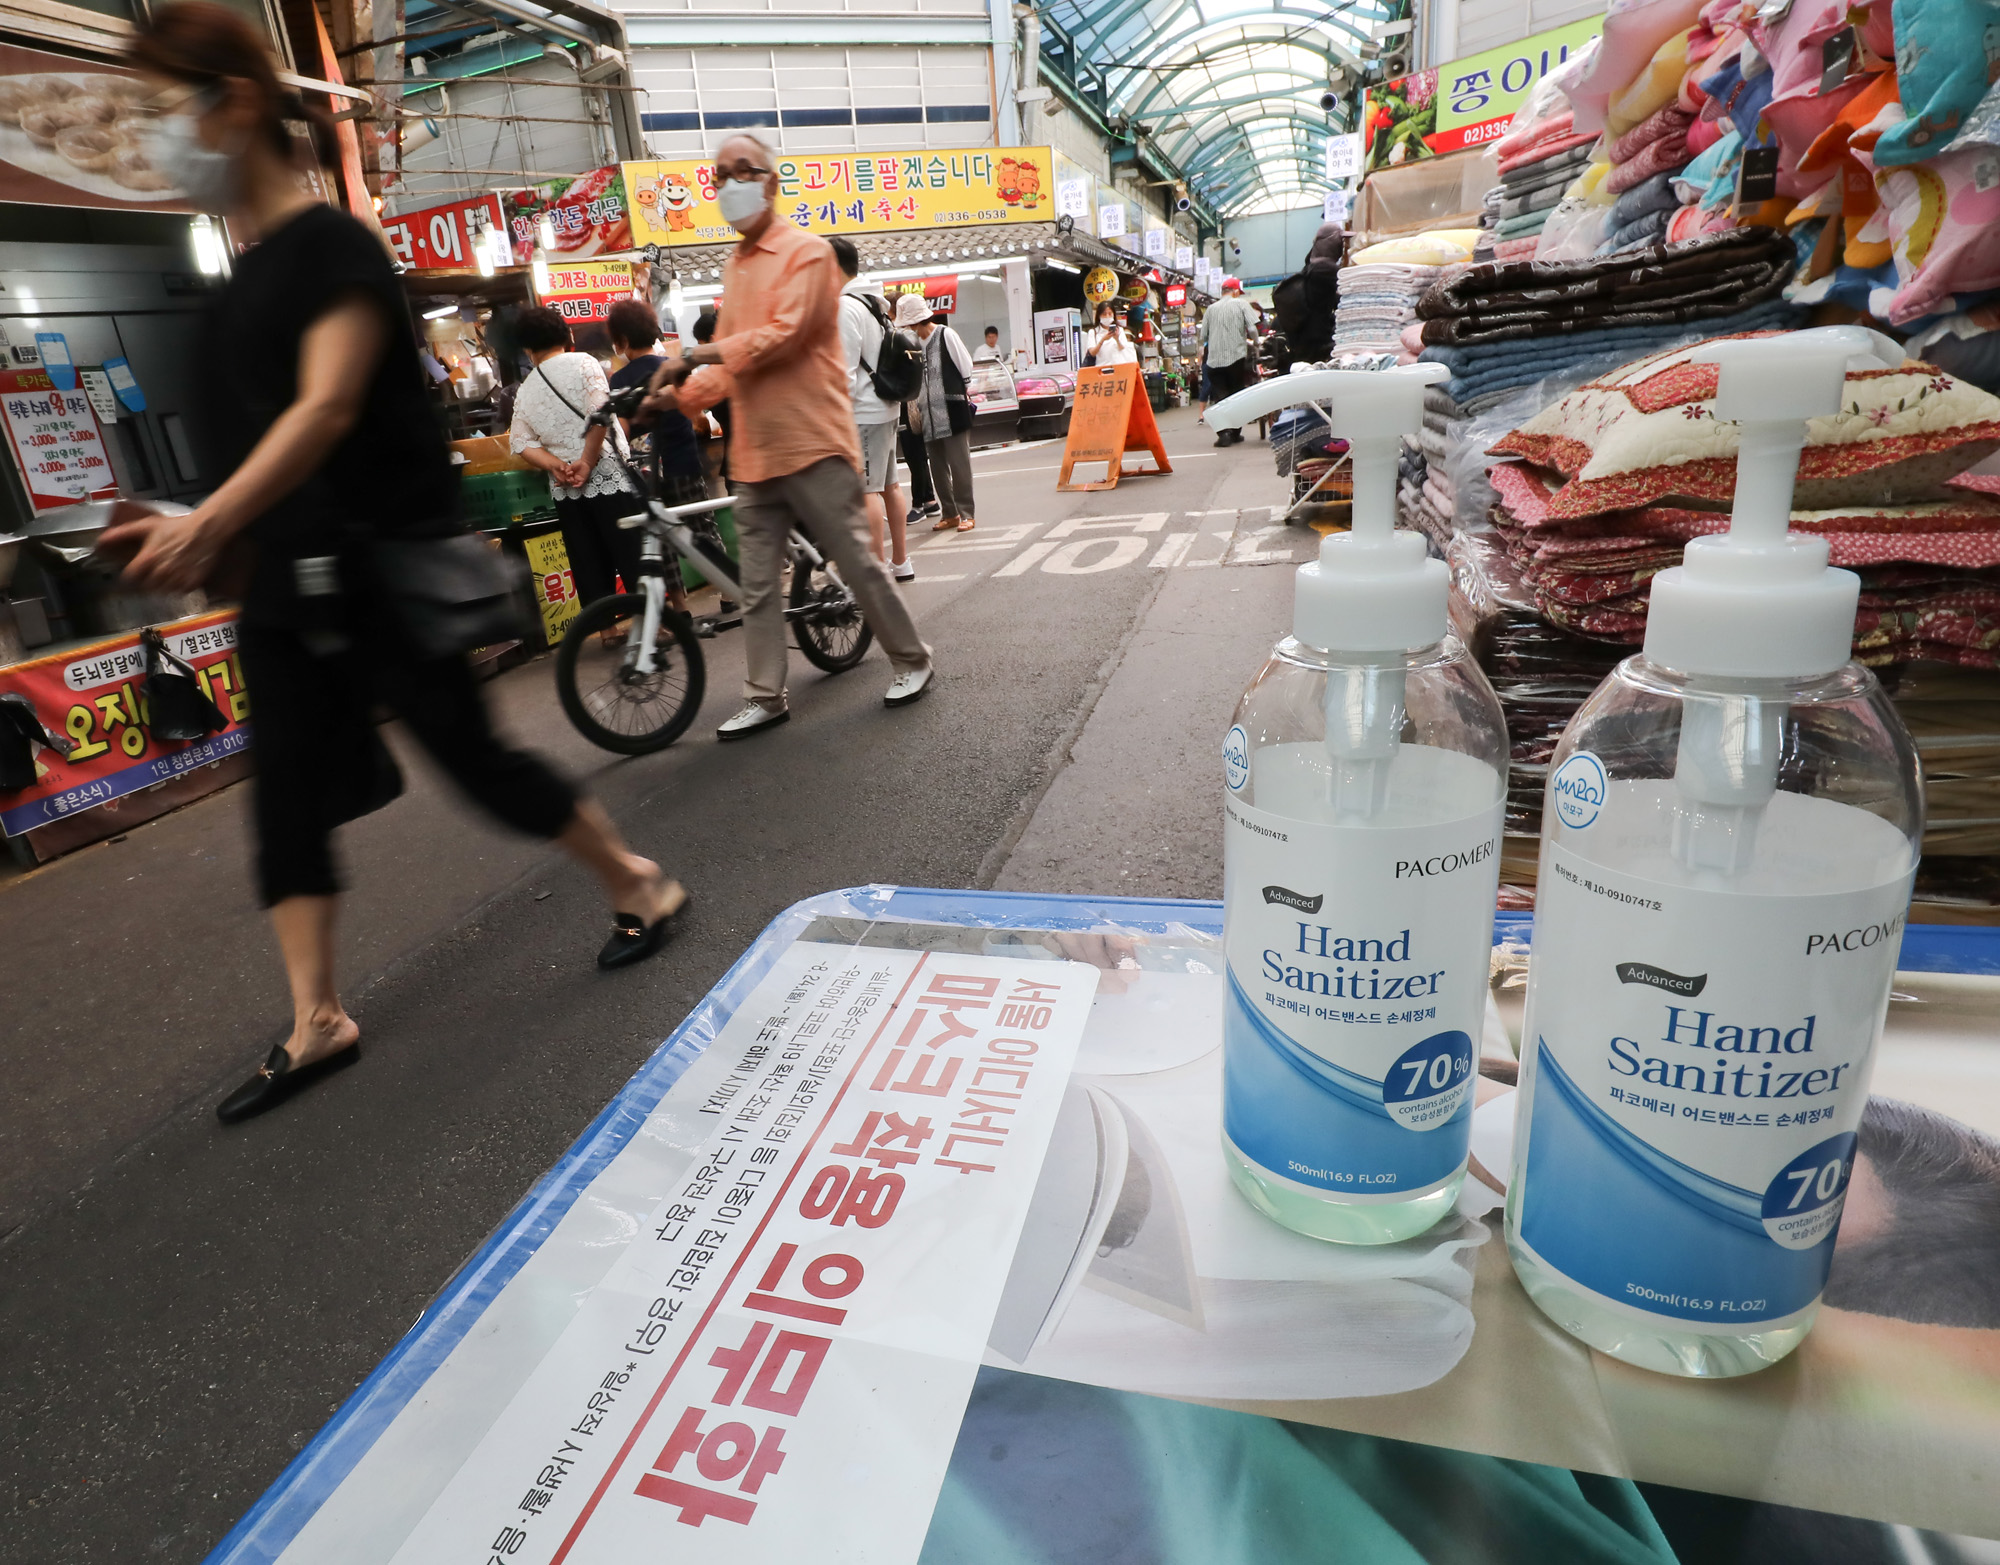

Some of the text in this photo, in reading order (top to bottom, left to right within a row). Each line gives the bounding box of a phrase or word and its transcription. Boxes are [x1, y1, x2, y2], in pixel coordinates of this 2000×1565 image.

[1449, 42, 1575, 113] 쫑이
[695, 154, 993, 200] 항 은고기를팔겠습니다
[586, 196, 622, 225] 전문
[790, 196, 920, 228] 윤가네 축산
[925, 295, 953, 311] 니다
[1079, 379, 1128, 399] 주차금지
[71, 650, 144, 686] 두뇌발달에
[1563, 801, 1583, 818] 마포구
[1395, 838, 1495, 879] PACOMERI
[1269, 889, 1314, 909] Advanced
[1554, 862, 1579, 887] 특허번호
[1592, 883, 1663, 912] 10-0910747호
[1295, 921, 1411, 962] Hand
[1262, 949, 1445, 1000] Sanitizer
[1627, 967, 1693, 992] Advanced
[1265, 992, 1436, 1024] 파코메리 어드밴스드 손세정제
[781, 1010, 829, 1060] 코로나19
[1661, 1005, 1816, 1053] Hand
[734, 1045, 770, 1072] 해제
[934, 978, 1061, 1175] 서울 어디서나
[1401, 1052, 1469, 1096] 70%
[1607, 1036, 1849, 1098] Sanitizer
[759, 1063, 794, 1093] 확산
[735, 1093, 771, 1123] 초래
[1398, 1099, 1438, 1115] contains
[1609, 1086, 1834, 1127] 파코메리 어드밴스드 손세정제
[721, 1125, 749, 1143] 시
[681, 1147, 736, 1200] 구상권
[750, 1147, 779, 1165] 등
[1287, 1160, 1353, 1183] 500ml(16.9
[711, 1169, 766, 1225] 다중이
[655, 1203, 697, 1242] 청구
[1778, 1214, 1821, 1231] contains
[633, 974, 1001, 1528] 마스크 착용 의무화
[666, 1229, 728, 1293] 집합한
[1625, 1283, 1714, 1311] 500ml(16.9
[625, 1297, 684, 1355] 경우)
